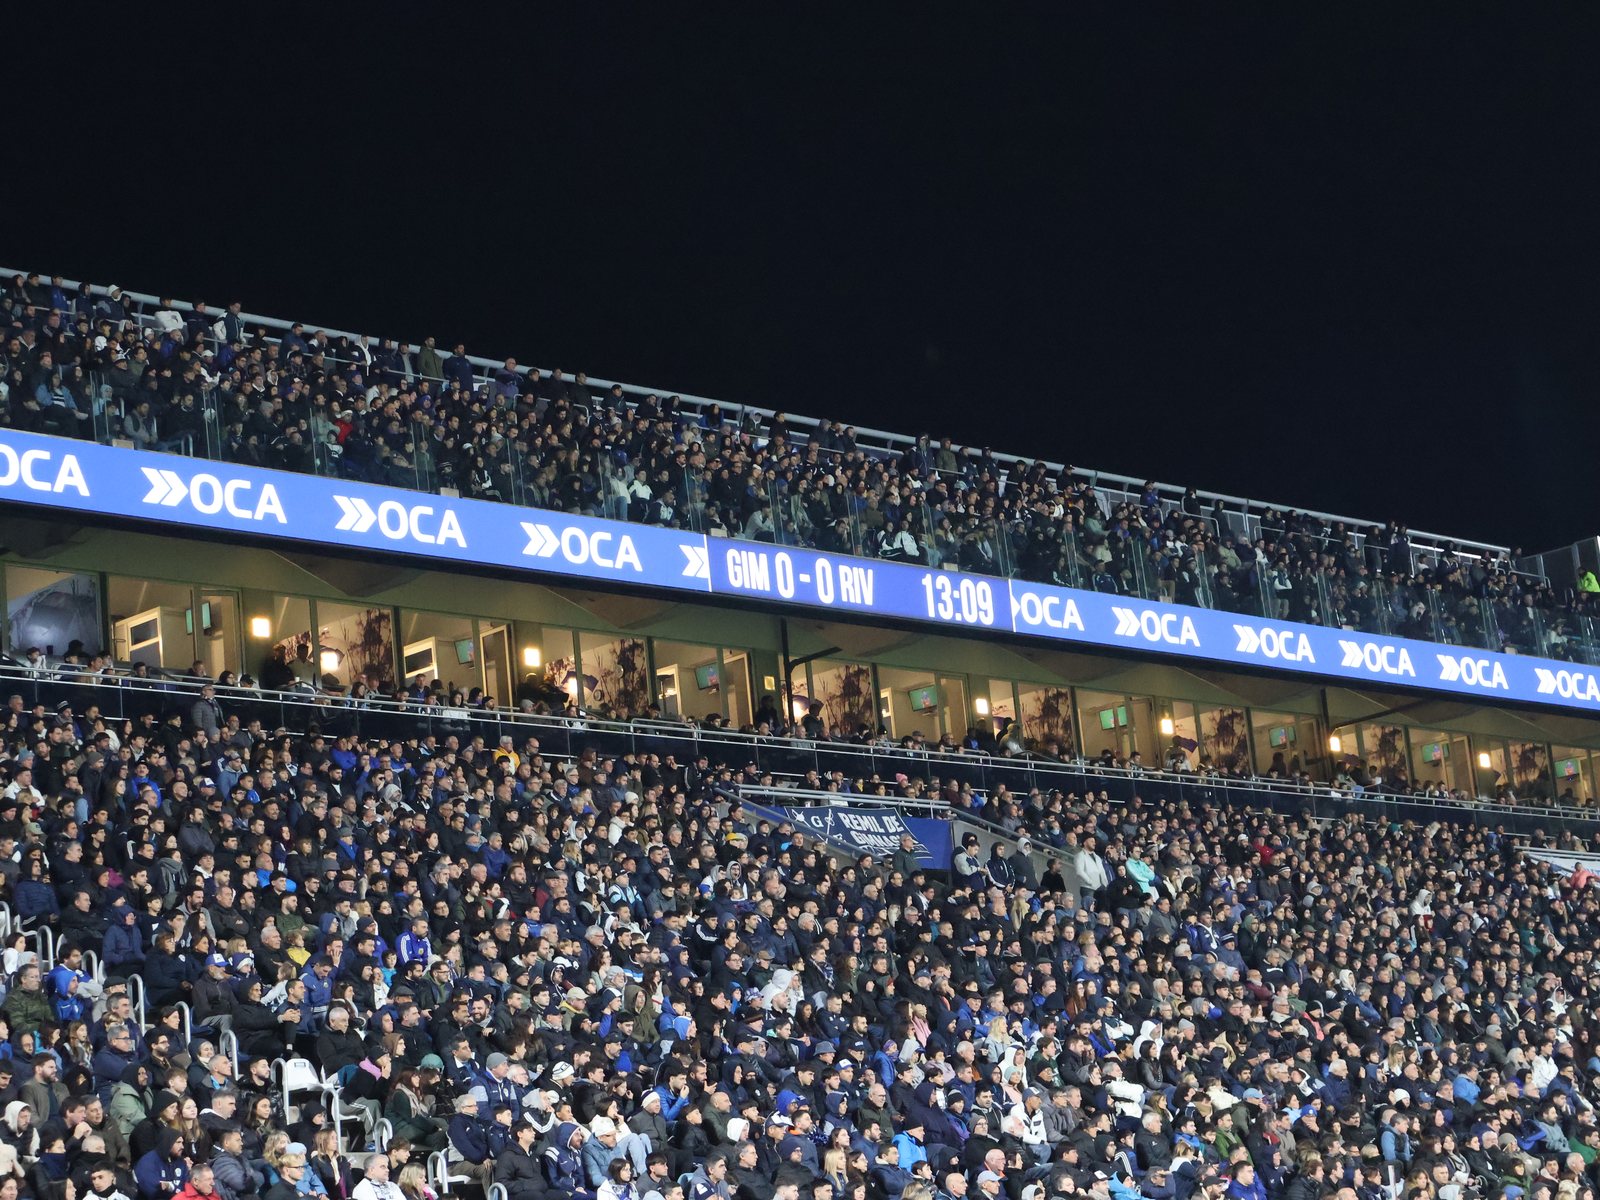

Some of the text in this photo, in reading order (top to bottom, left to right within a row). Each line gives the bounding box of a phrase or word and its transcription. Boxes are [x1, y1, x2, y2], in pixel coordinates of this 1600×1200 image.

[190, 474, 288, 524] OCA
[377, 500, 467, 548] OCA
[560, 526, 643, 572] OCA
[727, 548, 771, 592] GIM
[774, 551, 795, 599] 0
[815, 557, 835, 604] 0
[838, 564, 874, 606] RIV
[921, 573, 995, 626] 13:09
[1020, 592, 1085, 632] OCA
[1140, 610, 1200, 647] OCA
[1259, 628, 1316, 664] OCA
[1362, 643, 1416, 677] OCA
[1460, 657, 1509, 690] OCA
[1556, 669, 1600, 702] OCA
[838, 812, 904, 834] REMIL DE
[850, 830, 901, 848] GIMNAS
